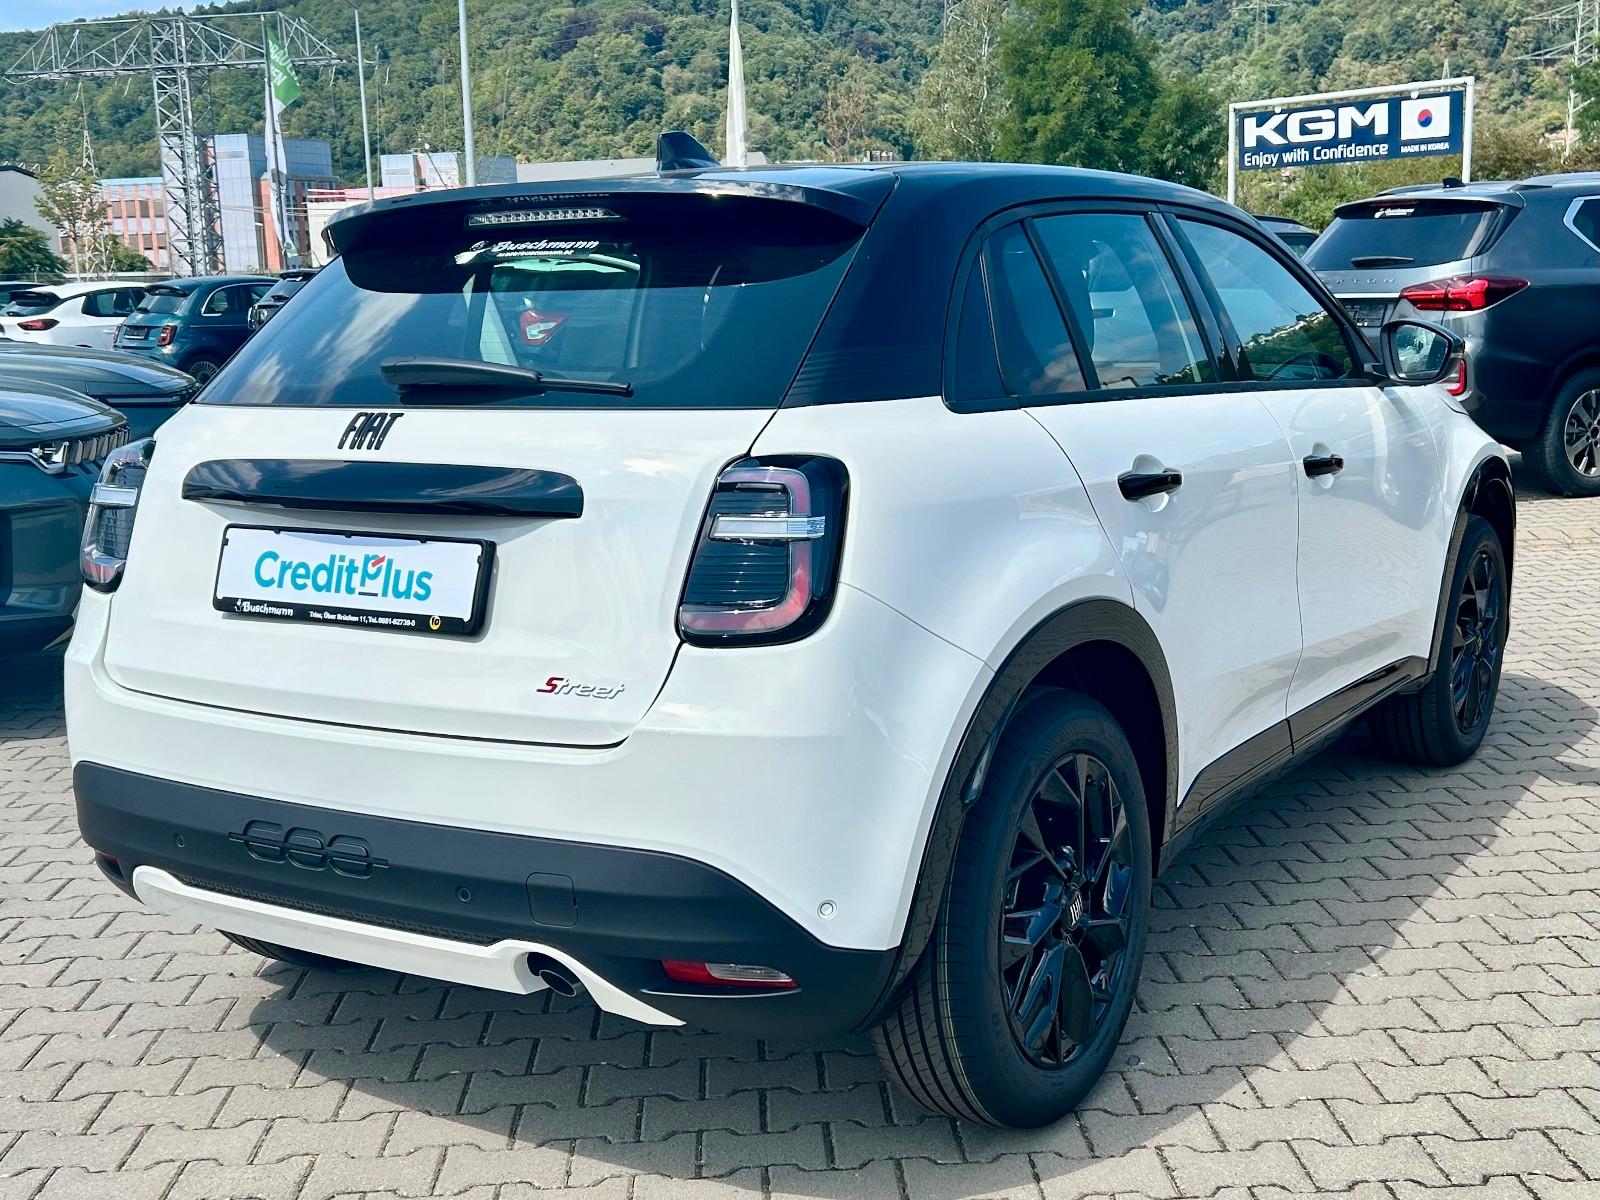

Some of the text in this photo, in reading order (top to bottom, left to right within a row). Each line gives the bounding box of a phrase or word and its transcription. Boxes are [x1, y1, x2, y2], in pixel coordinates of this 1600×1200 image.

[1243, 102, 1389, 148] KGM
[1244, 143, 1389, 168] Enjoy with Confidence
[1400, 142, 1450, 153] MADE IN KOREA
[491, 239, 600, 253] Buschmann
[337, 412, 405, 450] FIAT
[254, 550, 434, 601] CreditPlus
[241, 600, 294, 616] Buschmann
[536, 676, 625, 700] Street
[239, 819, 376, 880] 600
